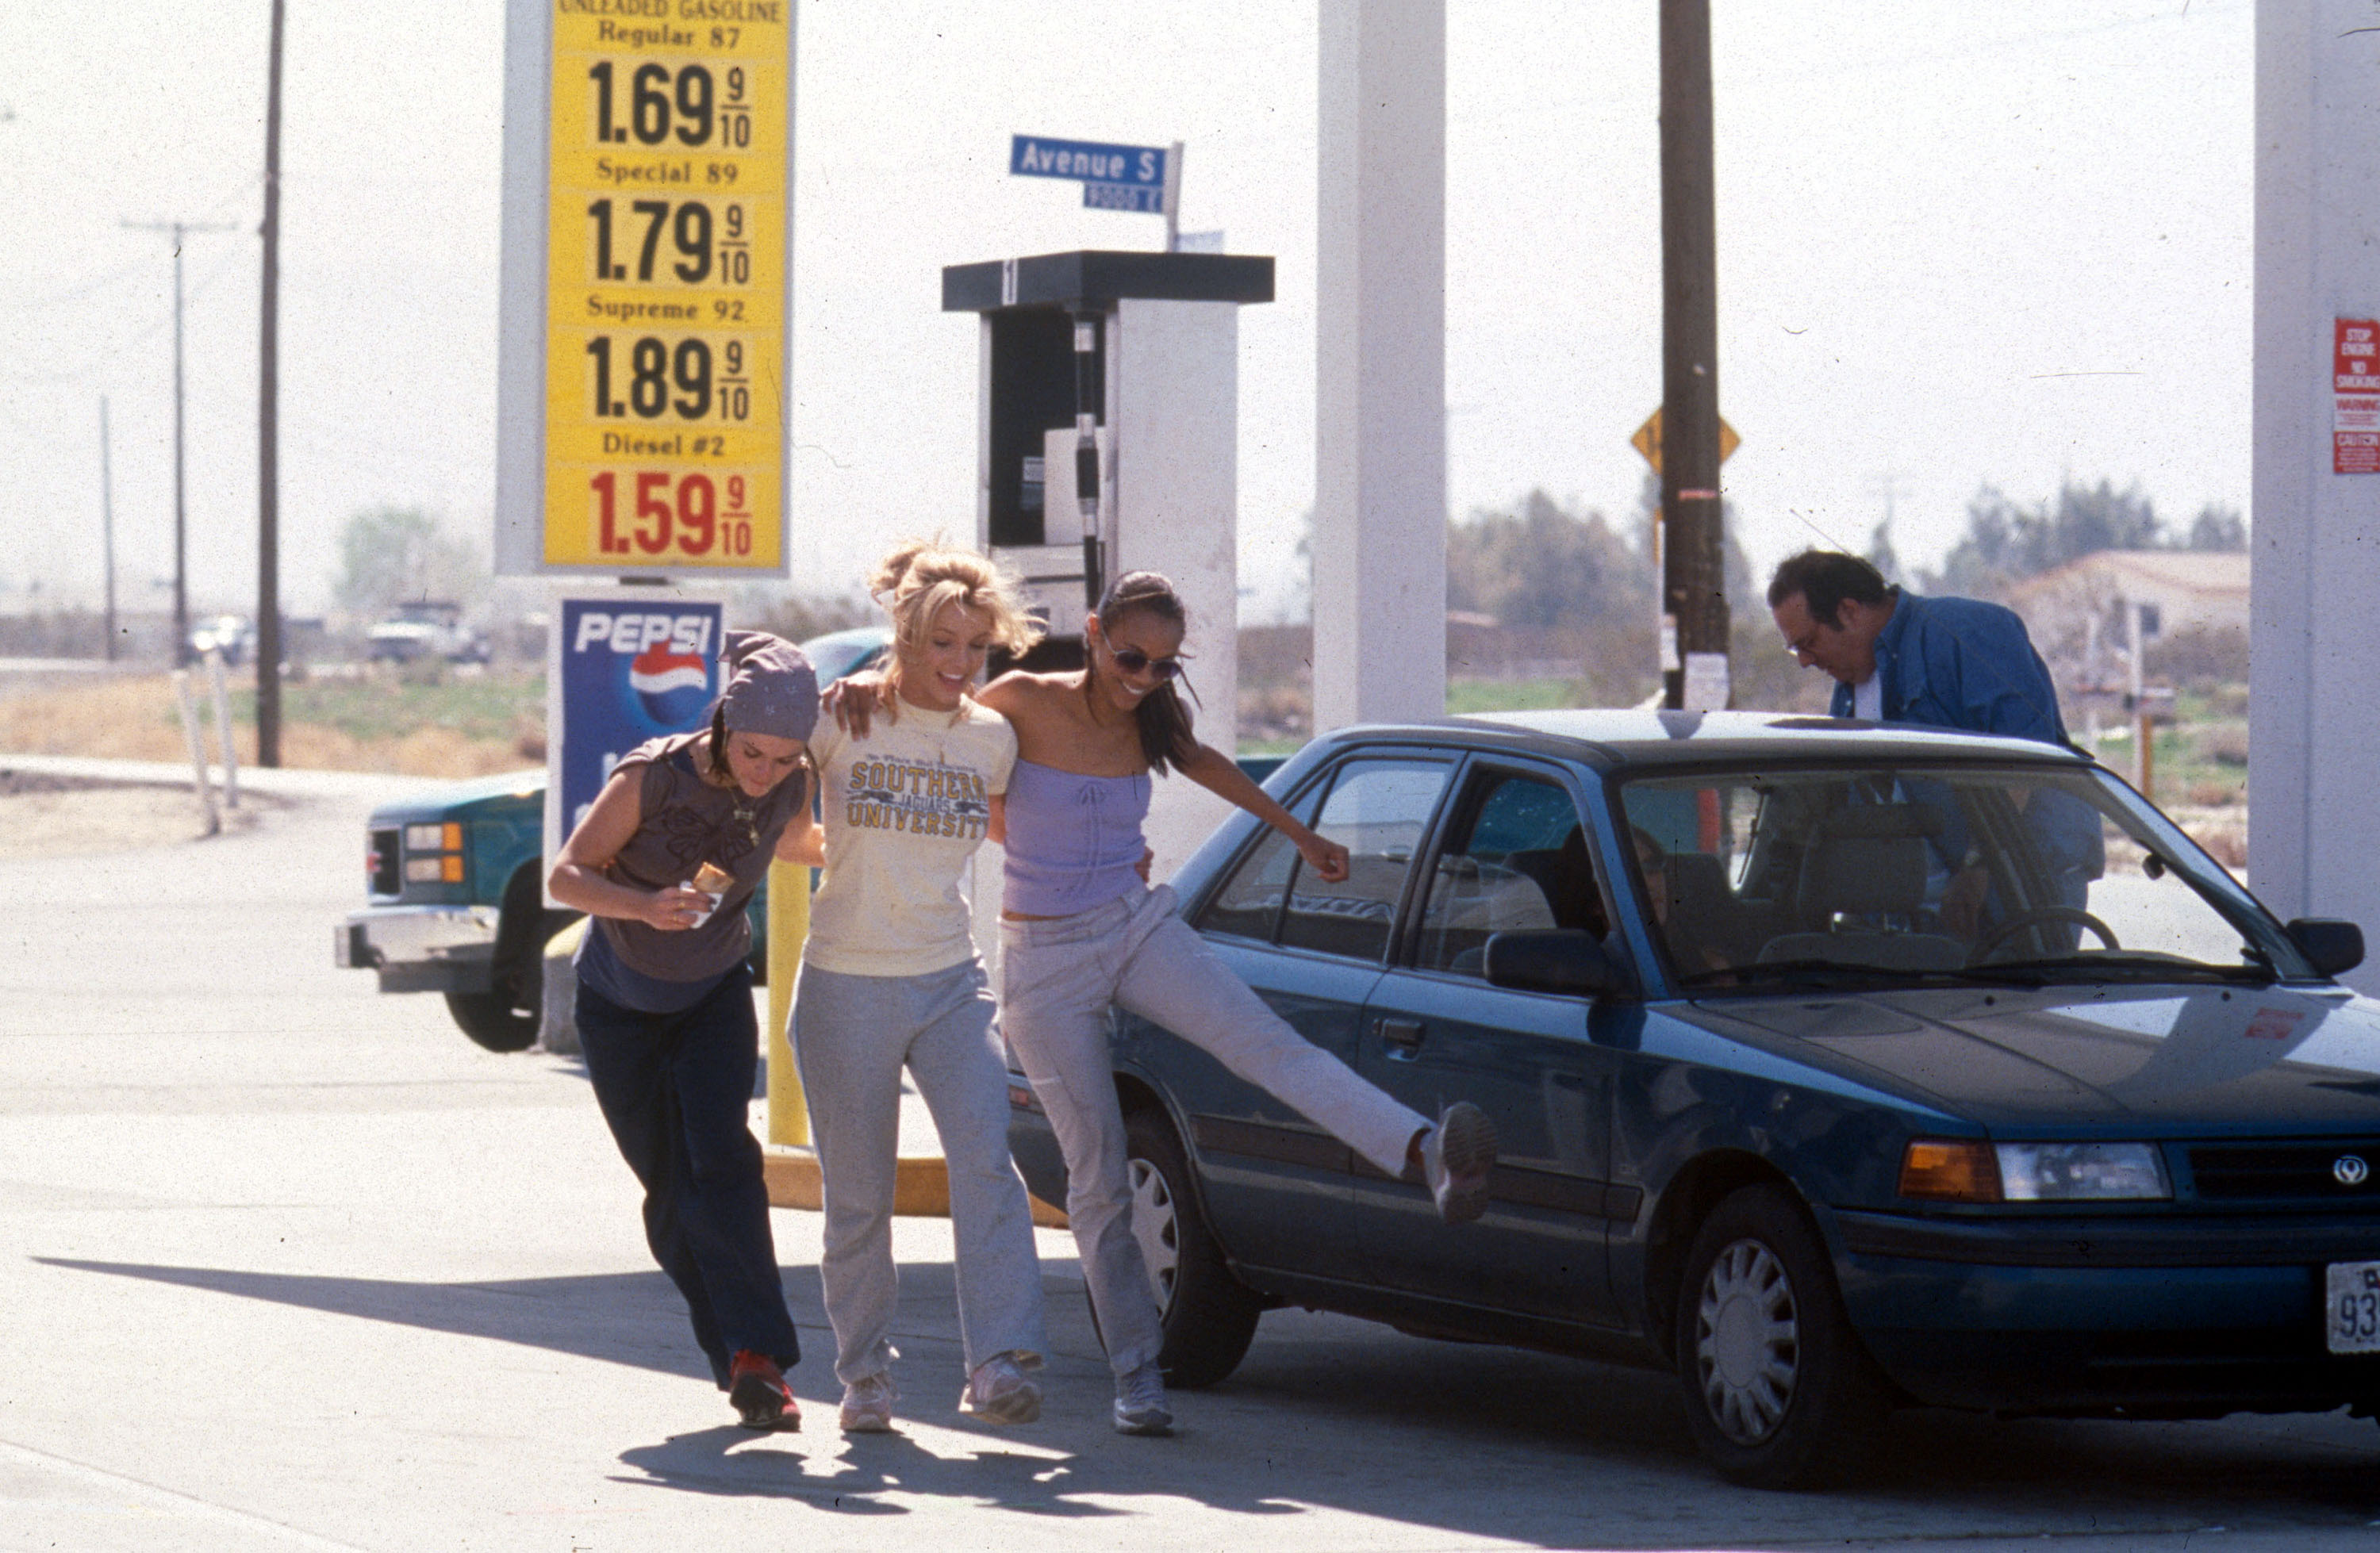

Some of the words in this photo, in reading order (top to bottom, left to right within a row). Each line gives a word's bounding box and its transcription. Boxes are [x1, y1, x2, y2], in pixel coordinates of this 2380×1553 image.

[559, 0, 668, 17] UNLEADED
[679, 1, 781, 22] GASOLINE
[599, 21, 694, 48] Regular
[710, 27, 740, 48] 87
[589, 61, 713, 146] 1.69
[597, 159, 691, 184] Special
[706, 163, 739, 183] 89
[1022, 141, 1125, 179] Avenue
[1138, 151, 1156, 182] S
[588, 198, 712, 284] 1.79
[587, 294, 698, 320] Supreme
[714, 301, 744, 320] 92
[586, 336, 712, 420] 1.89
[603, 433, 682, 454] Diesel
[693, 436, 725, 456] #2
[590, 471, 716, 556] 1.59
[574, 612, 712, 654] PEPSI
[849, 761, 987, 802] SOUTHERN
